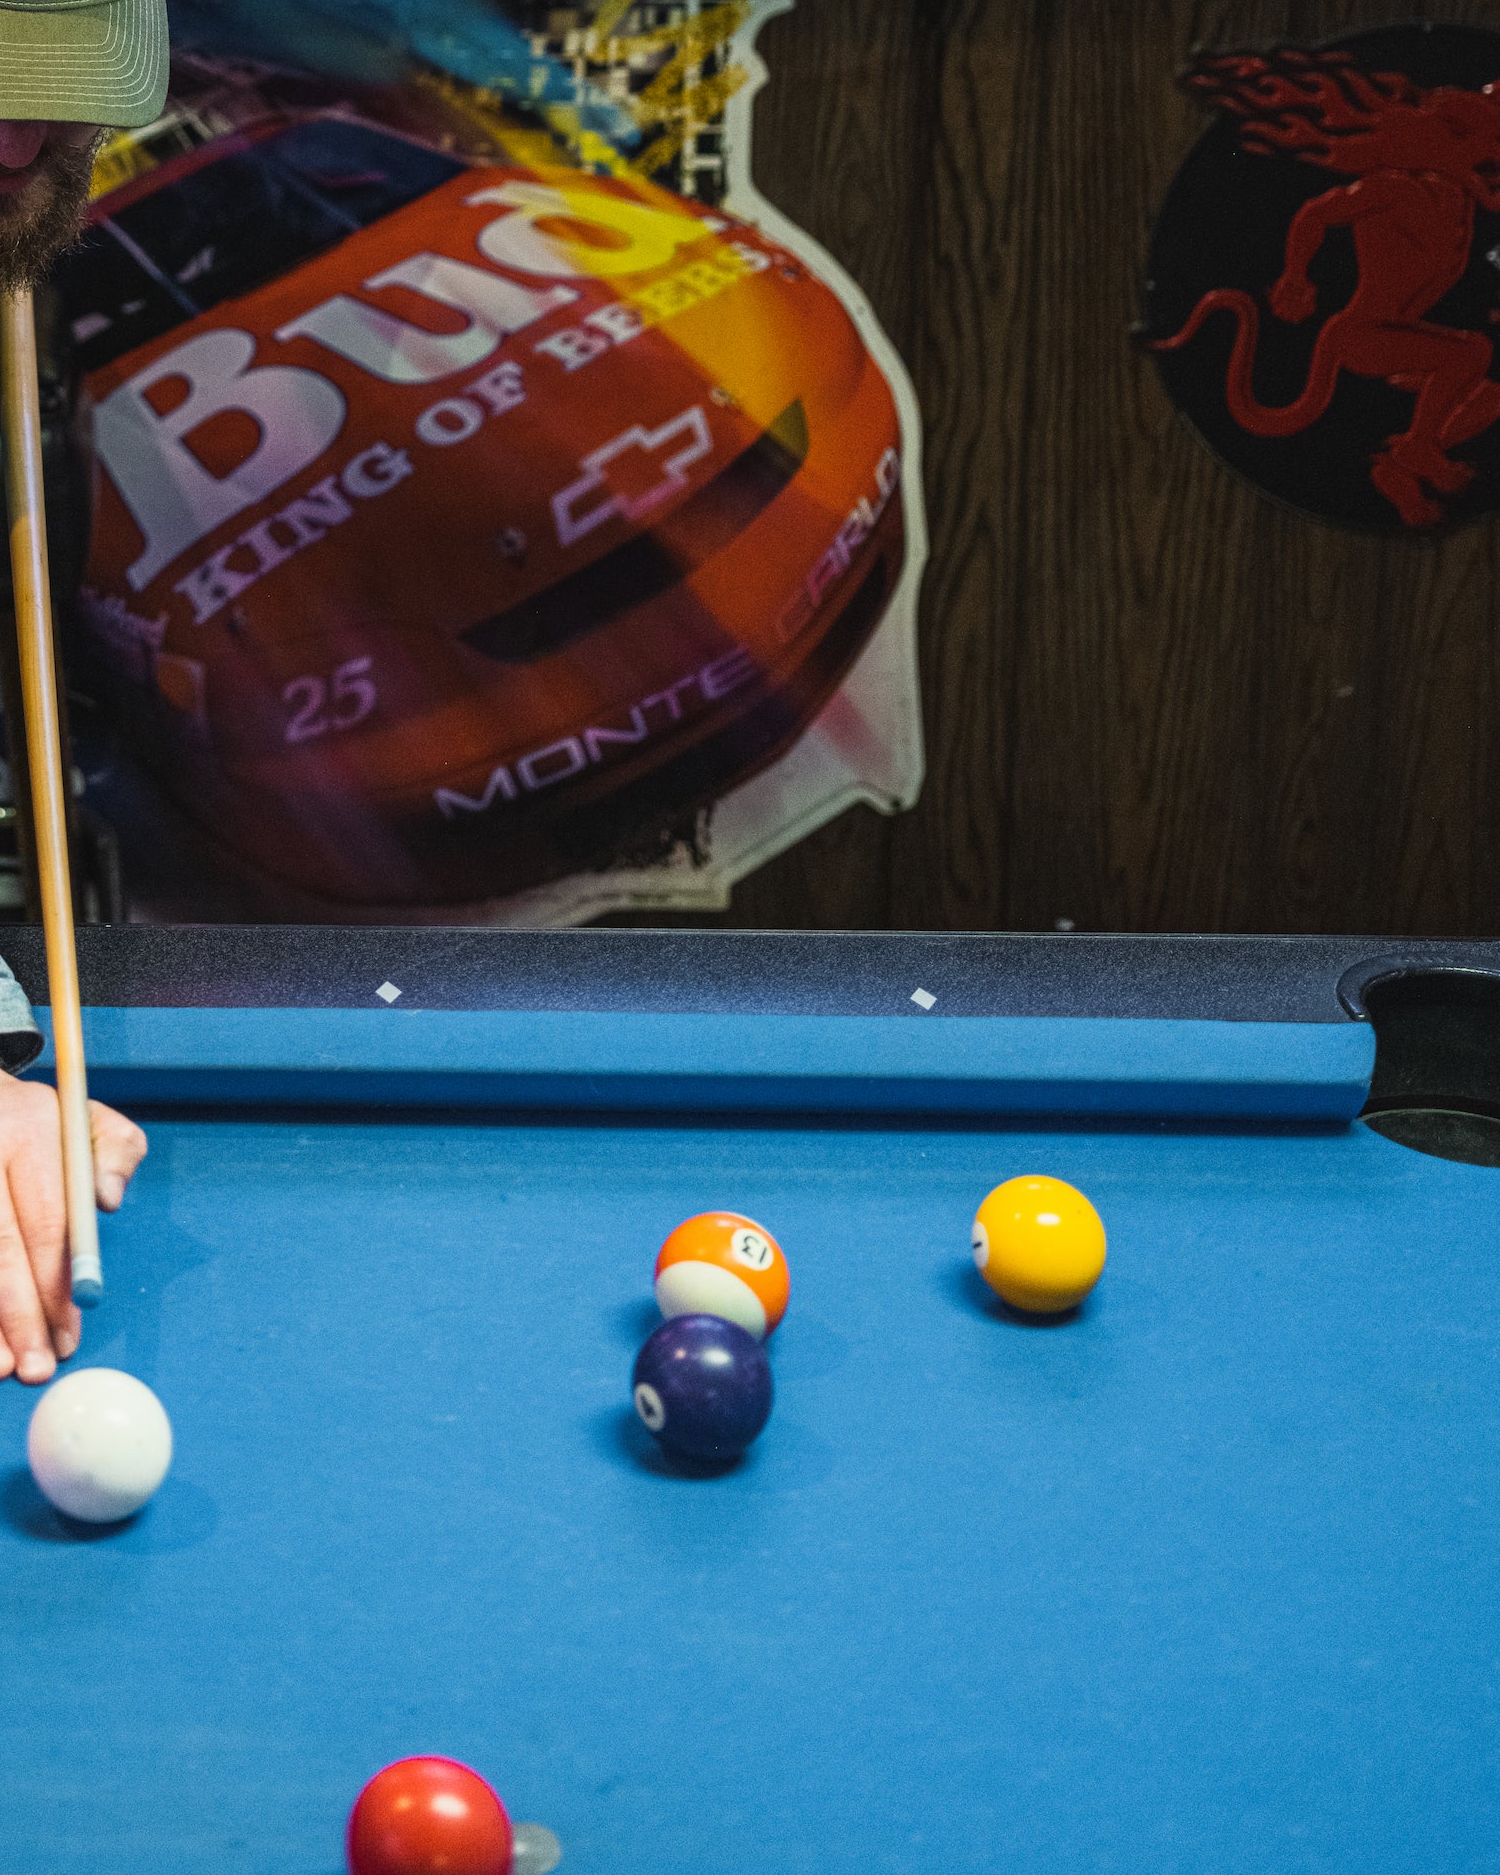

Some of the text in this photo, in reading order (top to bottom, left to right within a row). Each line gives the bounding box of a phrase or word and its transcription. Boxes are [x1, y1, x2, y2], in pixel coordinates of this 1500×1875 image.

[173, 441, 415, 627] KING
[414, 361, 529, 447] OF
[533, 240, 774, 373] BEERS
[281, 657, 378, 744] 25
[432, 446, 898, 820] MONTE CARLO
[741, 1234, 770, 1265] 13
